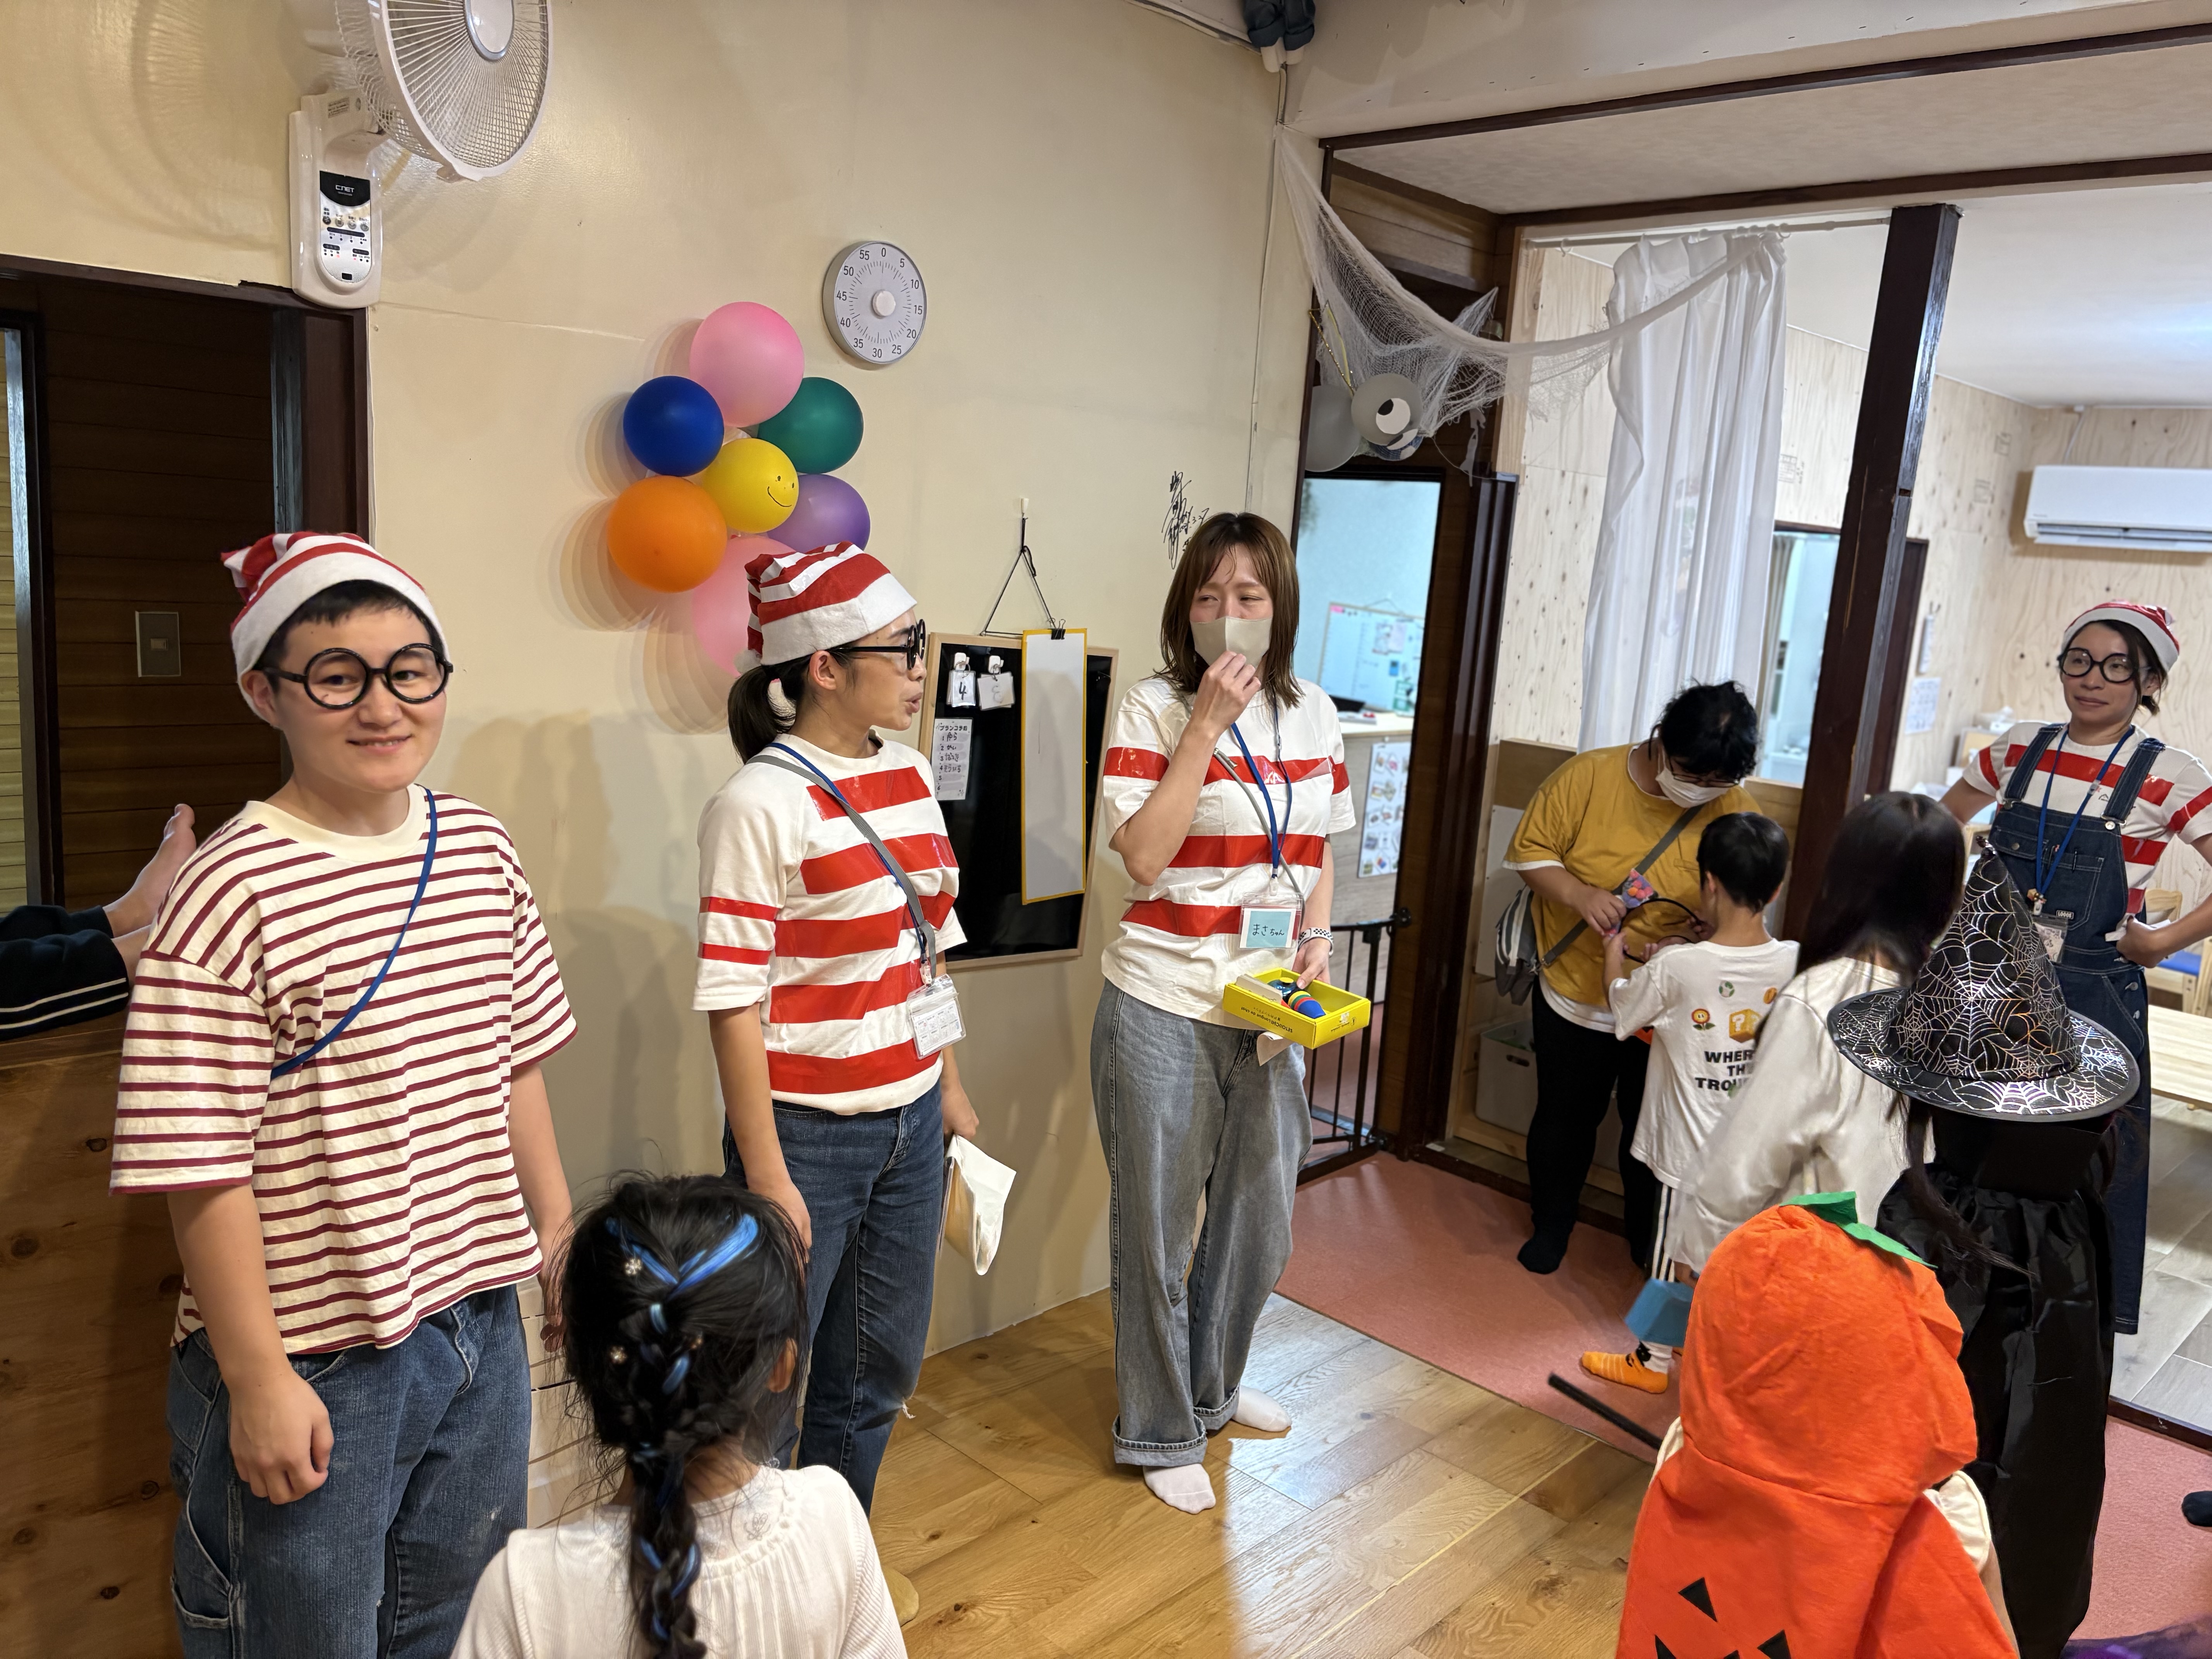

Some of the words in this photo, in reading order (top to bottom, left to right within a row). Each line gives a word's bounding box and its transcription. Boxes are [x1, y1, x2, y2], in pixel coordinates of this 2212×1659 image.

[859, 249, 870, 260] 55
[881, 248, 886, 257] 0
[900, 259, 905, 268] 5
[843, 266, 854, 276] 50
[910, 279, 919, 289] 10
[836, 290, 847, 301] 45
[914, 305, 922, 315] 15
[840, 318, 851, 328] 40
[907, 329, 916, 339] 20
[853, 338, 864, 348] 35
[872, 348, 882, 358] 30
[892, 345, 902, 354] 25
[959, 681, 967, 701] 4
[1252, 924, 1285, 936] まさちゃん
[1704, 1049, 1753, 1063] WHER
